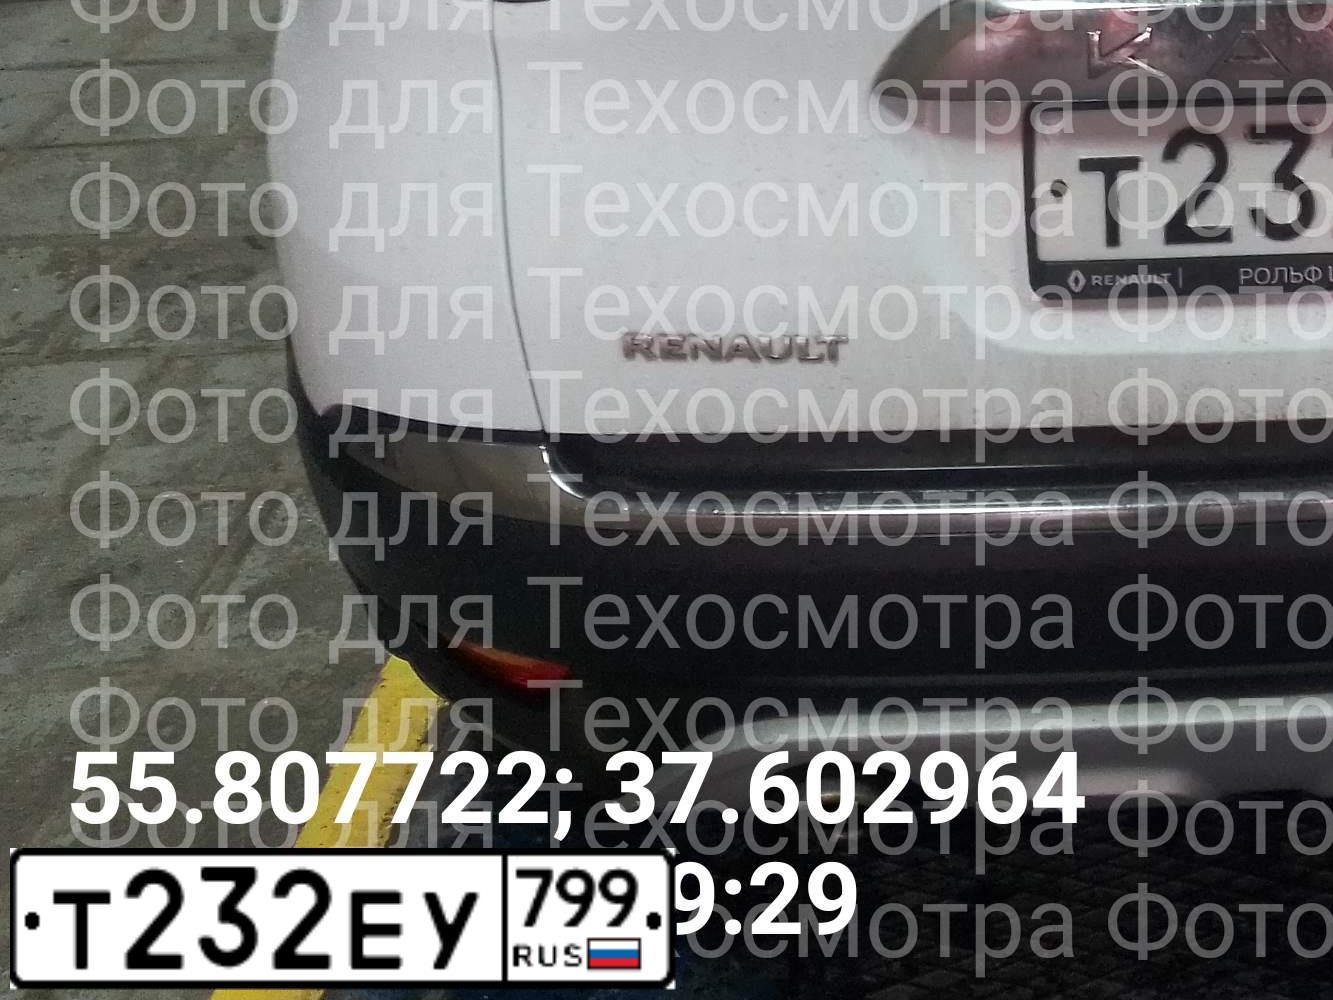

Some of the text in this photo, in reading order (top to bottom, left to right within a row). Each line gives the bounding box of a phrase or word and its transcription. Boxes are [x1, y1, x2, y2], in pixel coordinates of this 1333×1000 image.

[1091, 273, 1172, 287] RENAULT
[1238, 266, 1322, 285] РОЛЬФ
[623, 332, 849, 363] RENAULT
